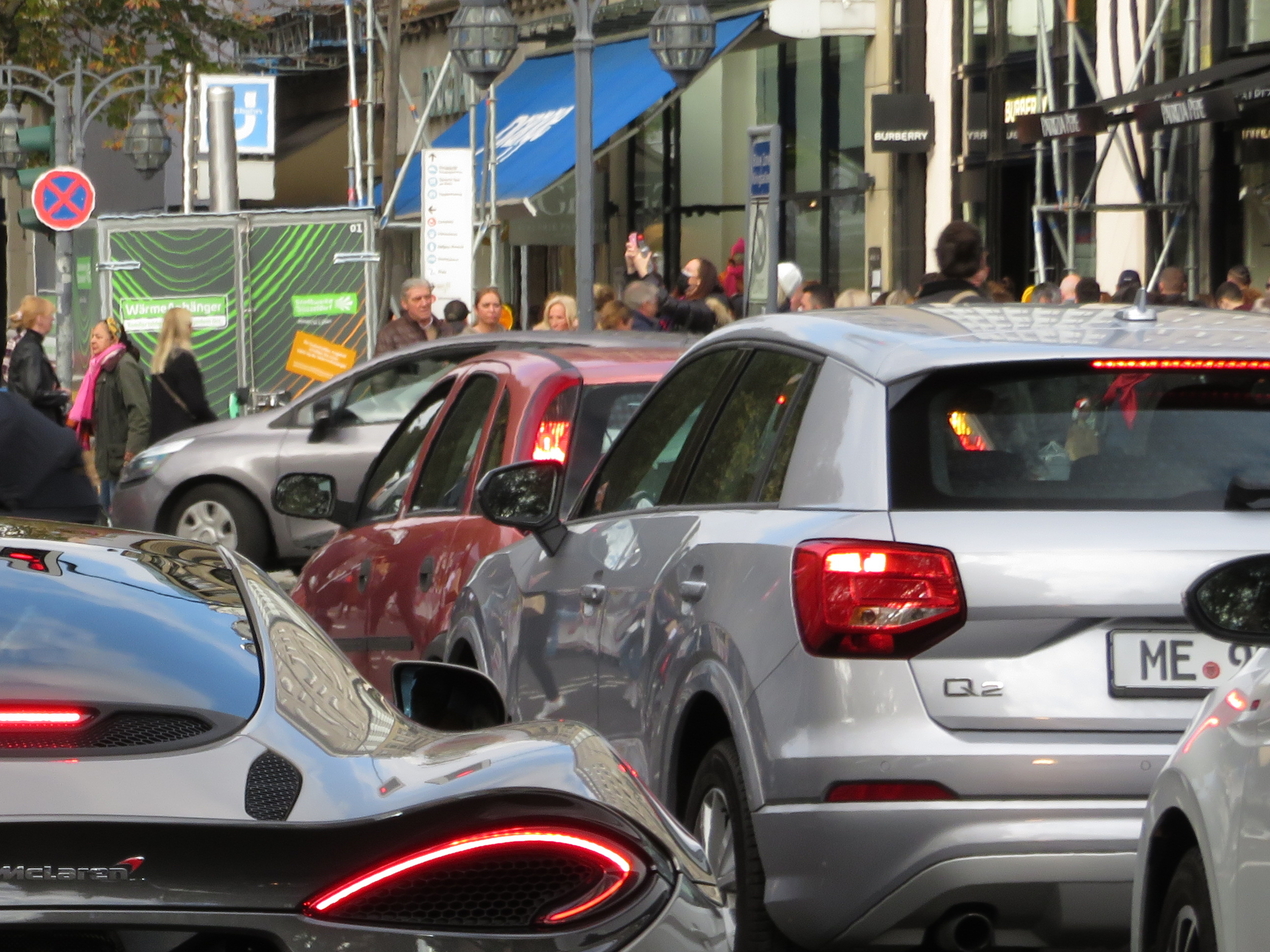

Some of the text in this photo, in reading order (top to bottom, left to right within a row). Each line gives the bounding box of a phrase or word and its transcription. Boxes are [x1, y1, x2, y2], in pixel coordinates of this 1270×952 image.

[874, 130, 928, 141] BURBERRY
[350, 223, 363, 233] 01
[1139, 639, 1197, 681] ME
[943, 678, 1004, 697] Q2
